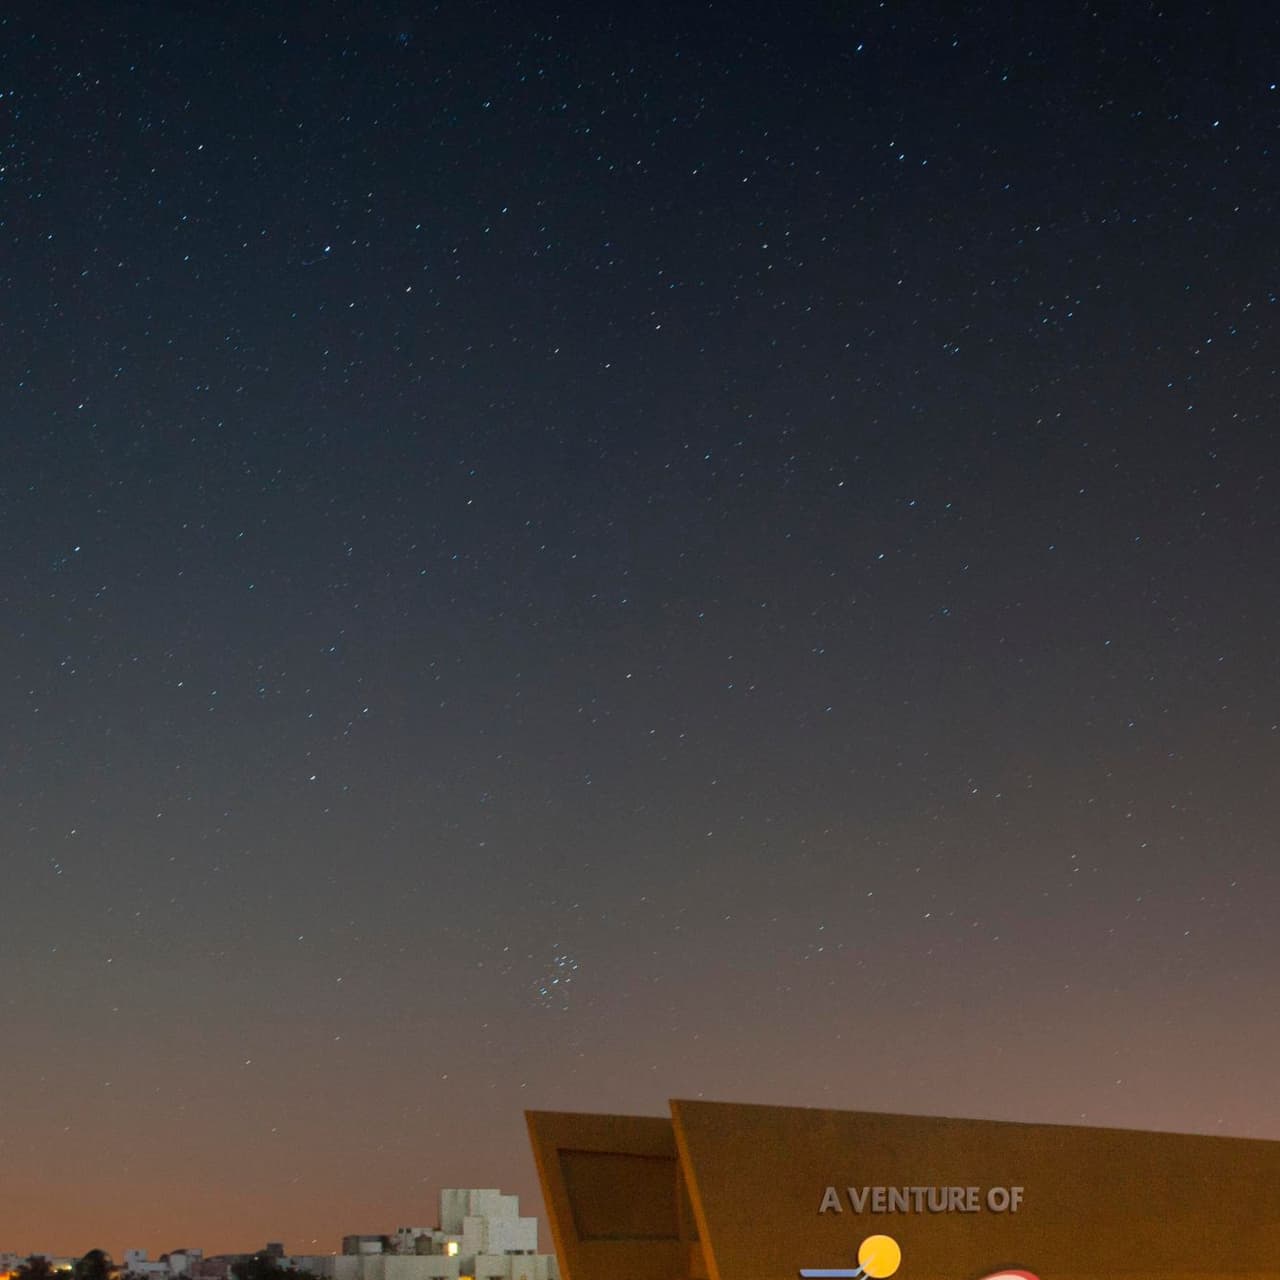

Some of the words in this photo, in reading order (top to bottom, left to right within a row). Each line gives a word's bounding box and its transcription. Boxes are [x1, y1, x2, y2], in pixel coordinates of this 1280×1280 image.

[819, 1186, 843, 1213] A
[847, 1186, 981, 1214] VENTURE
[987, 1186, 1025, 1212] OF
